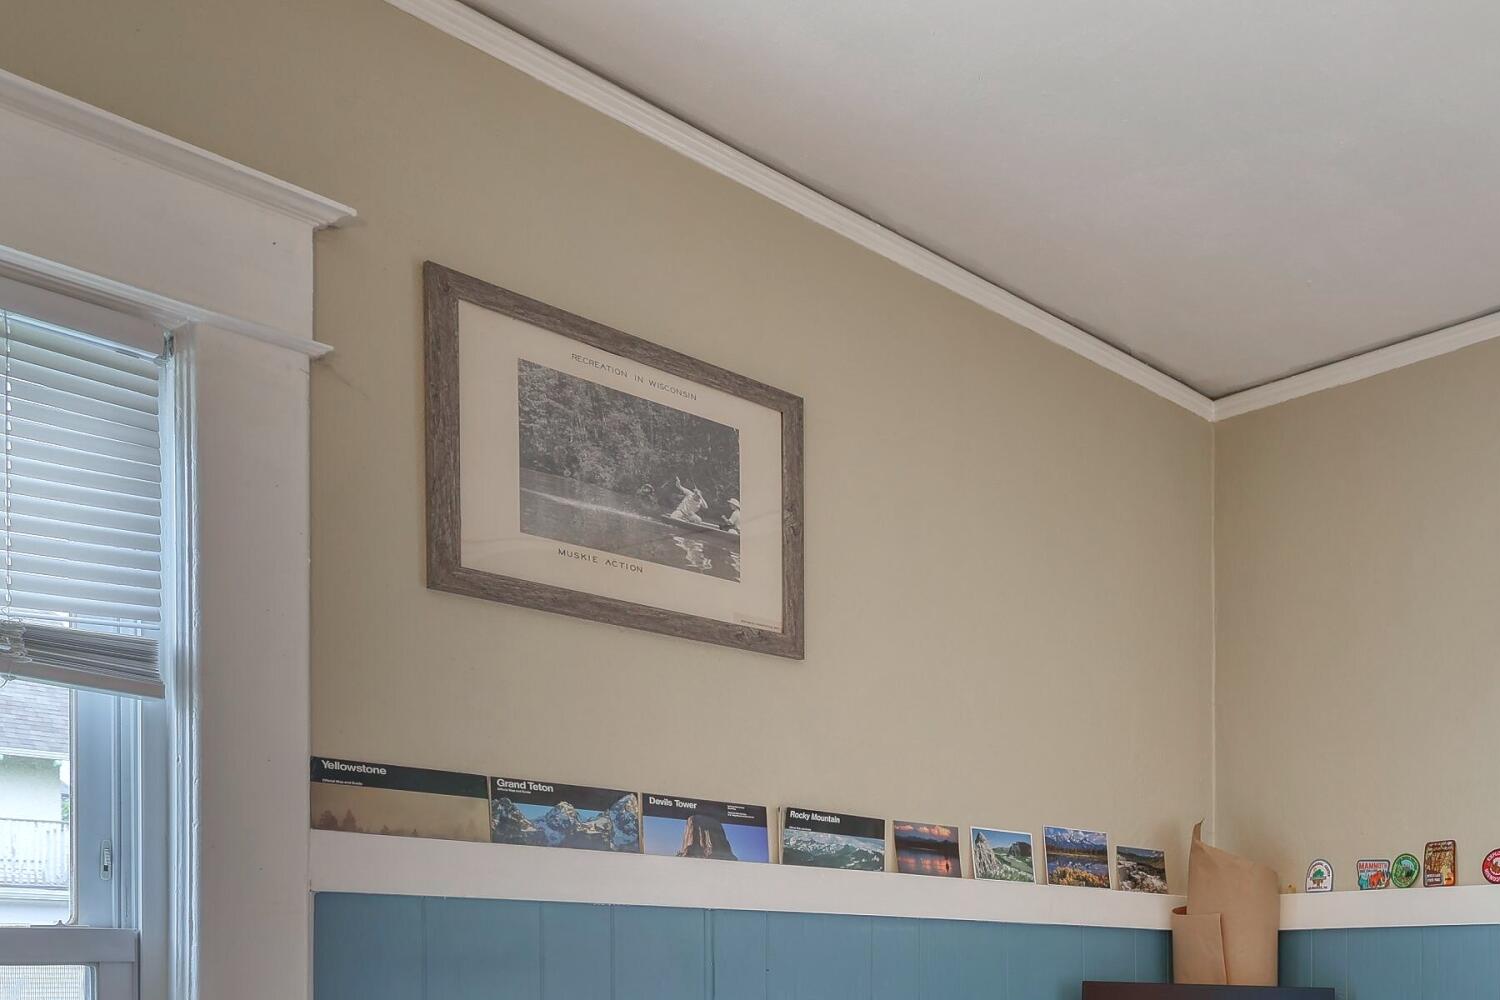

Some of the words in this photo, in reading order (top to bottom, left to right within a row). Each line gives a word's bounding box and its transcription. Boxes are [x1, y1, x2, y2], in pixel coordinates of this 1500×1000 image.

[571, 353, 628, 378] RECREATION
[634, 374, 644, 384] IN
[648, 379, 697, 401] WISCONSIN
[558, 548, 598, 564] MUSKIE
[605, 559, 643, 573] ACTION
[321, 760, 387, 775] Yellowstone
[496, 778, 527, 790] Grand
[527, 781, 554, 793] Teton
[649, 796, 673, 807] Devils
[674, 799, 697, 809] Tower
[790, 810, 810, 821] Rocky
[811, 812, 841, 824] Mountain
